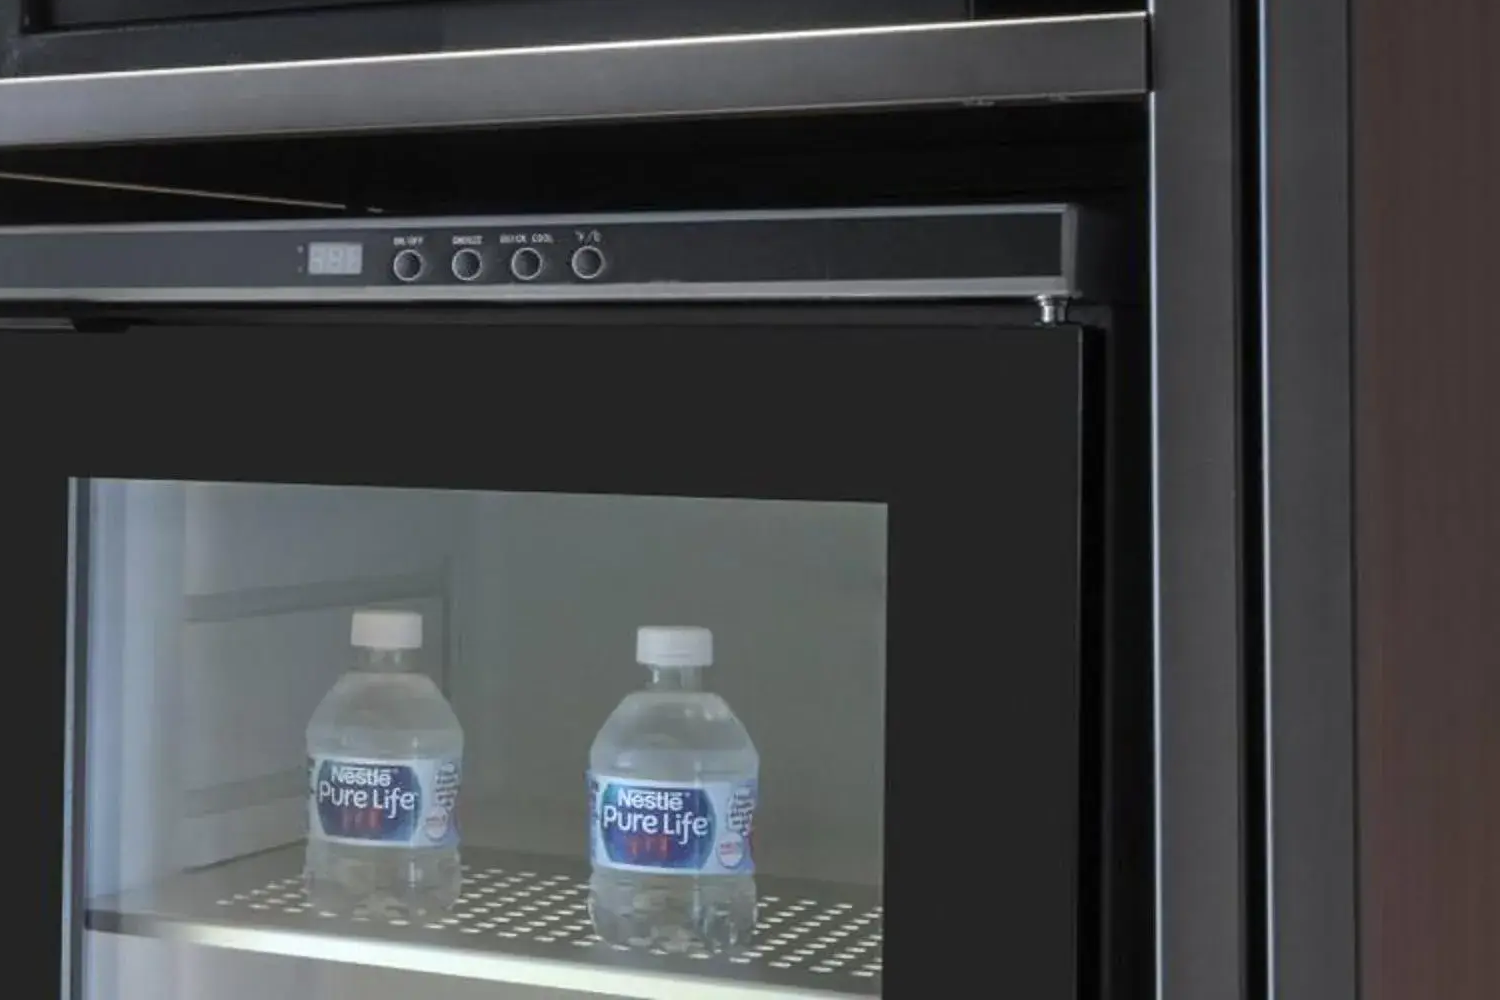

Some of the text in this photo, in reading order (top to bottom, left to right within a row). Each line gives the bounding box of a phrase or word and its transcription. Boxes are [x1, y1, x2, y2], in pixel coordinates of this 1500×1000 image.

[331, 765, 392, 787] Nestlé
[319, 781, 368, 809] Pure
[373, 786, 415, 819] Life
[618, 788, 684, 811] Nestlé
[604, 805, 659, 833] Pure
[663, 810, 708, 846] Life
